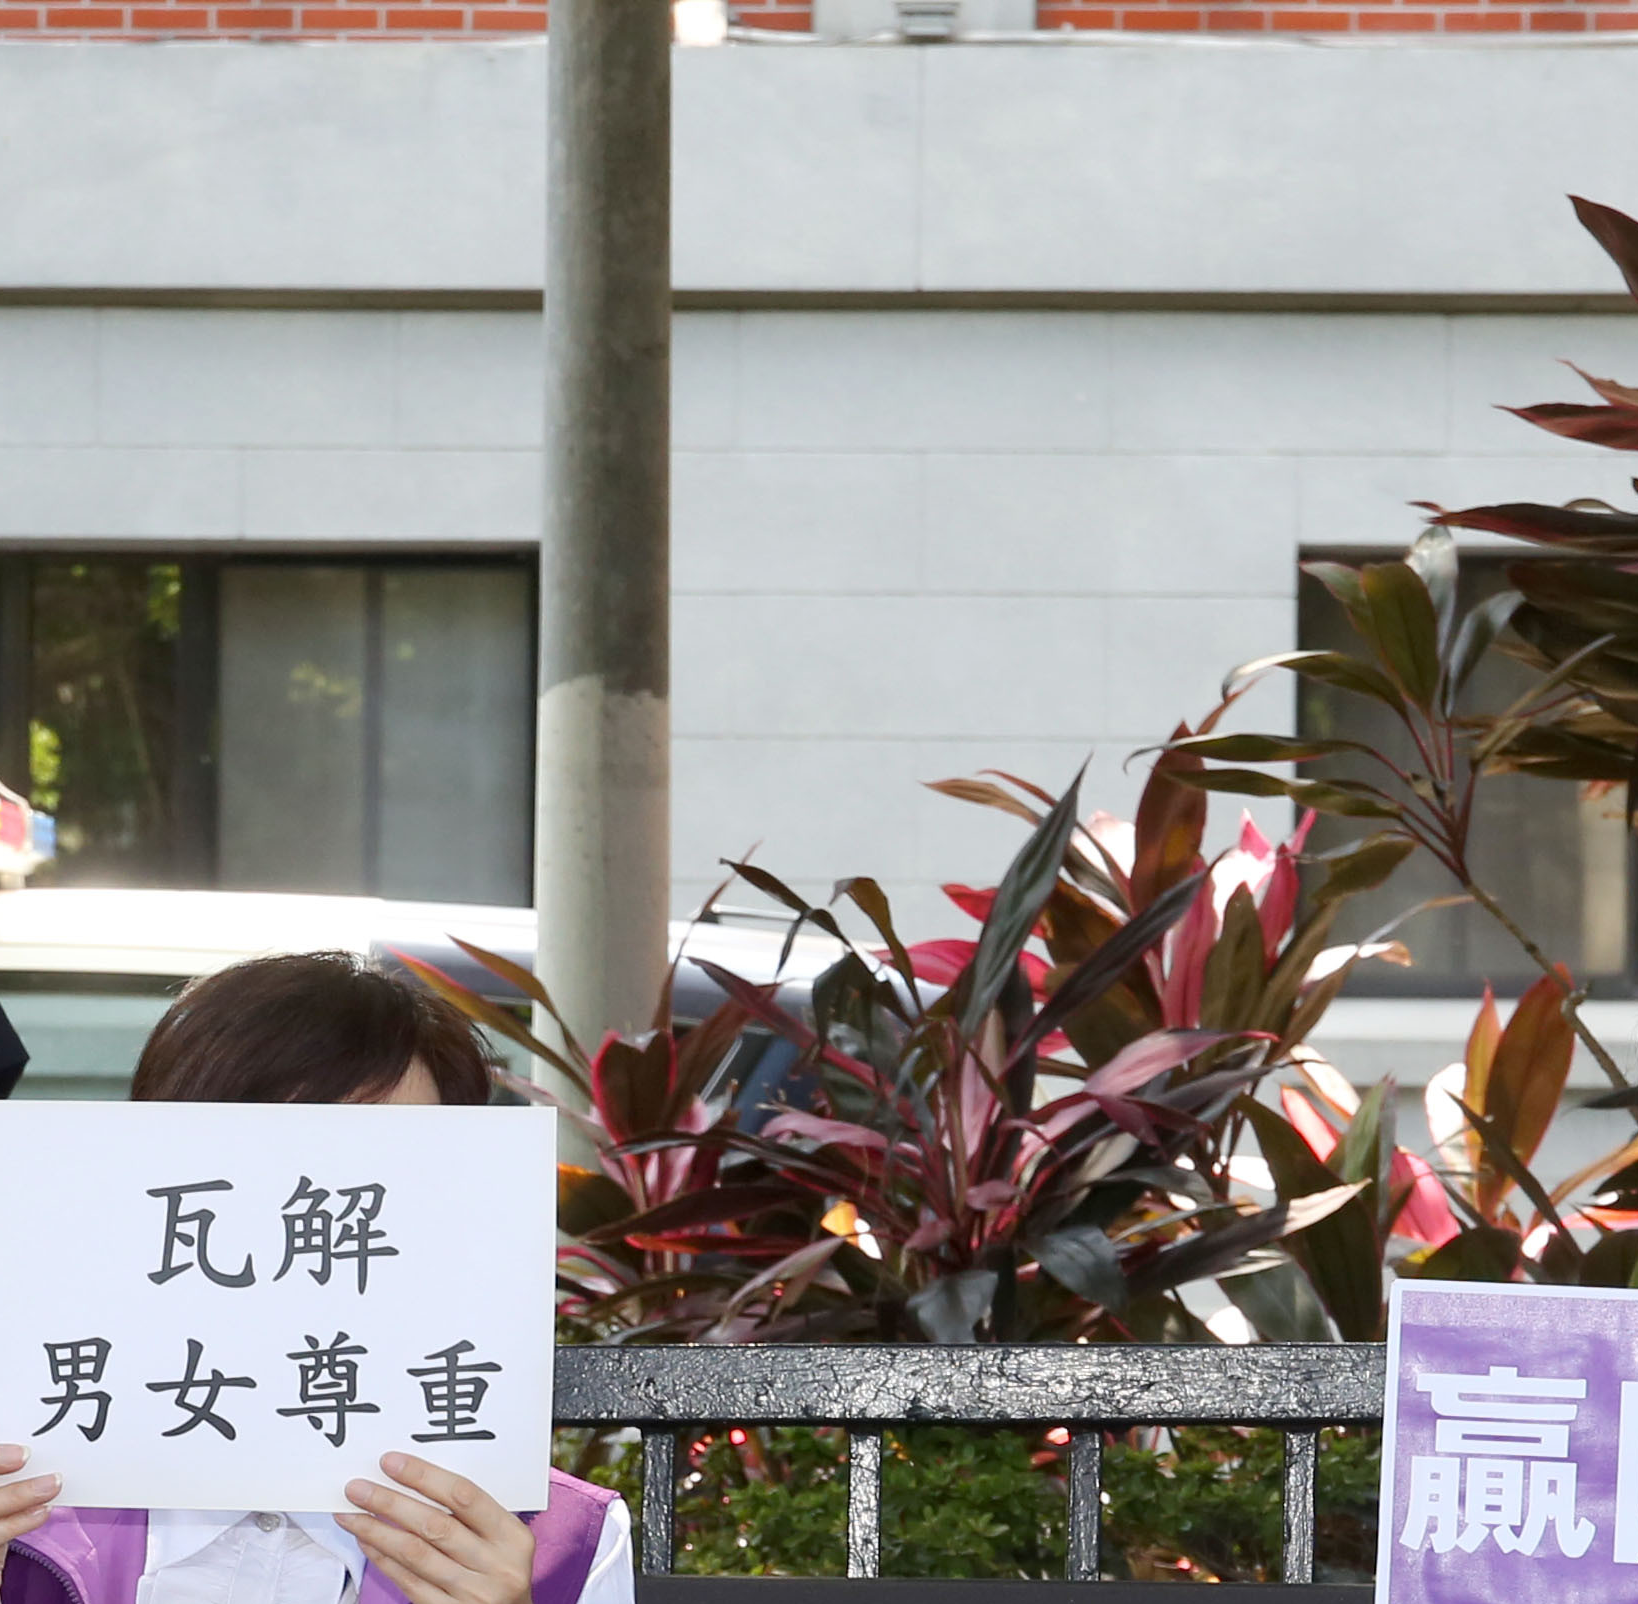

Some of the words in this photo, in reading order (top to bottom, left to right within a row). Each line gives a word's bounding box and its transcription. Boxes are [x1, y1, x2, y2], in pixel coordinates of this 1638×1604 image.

[146, 1175, 400, 1295] 瓦解
[31, 1331, 503, 1448] 男女尊重
